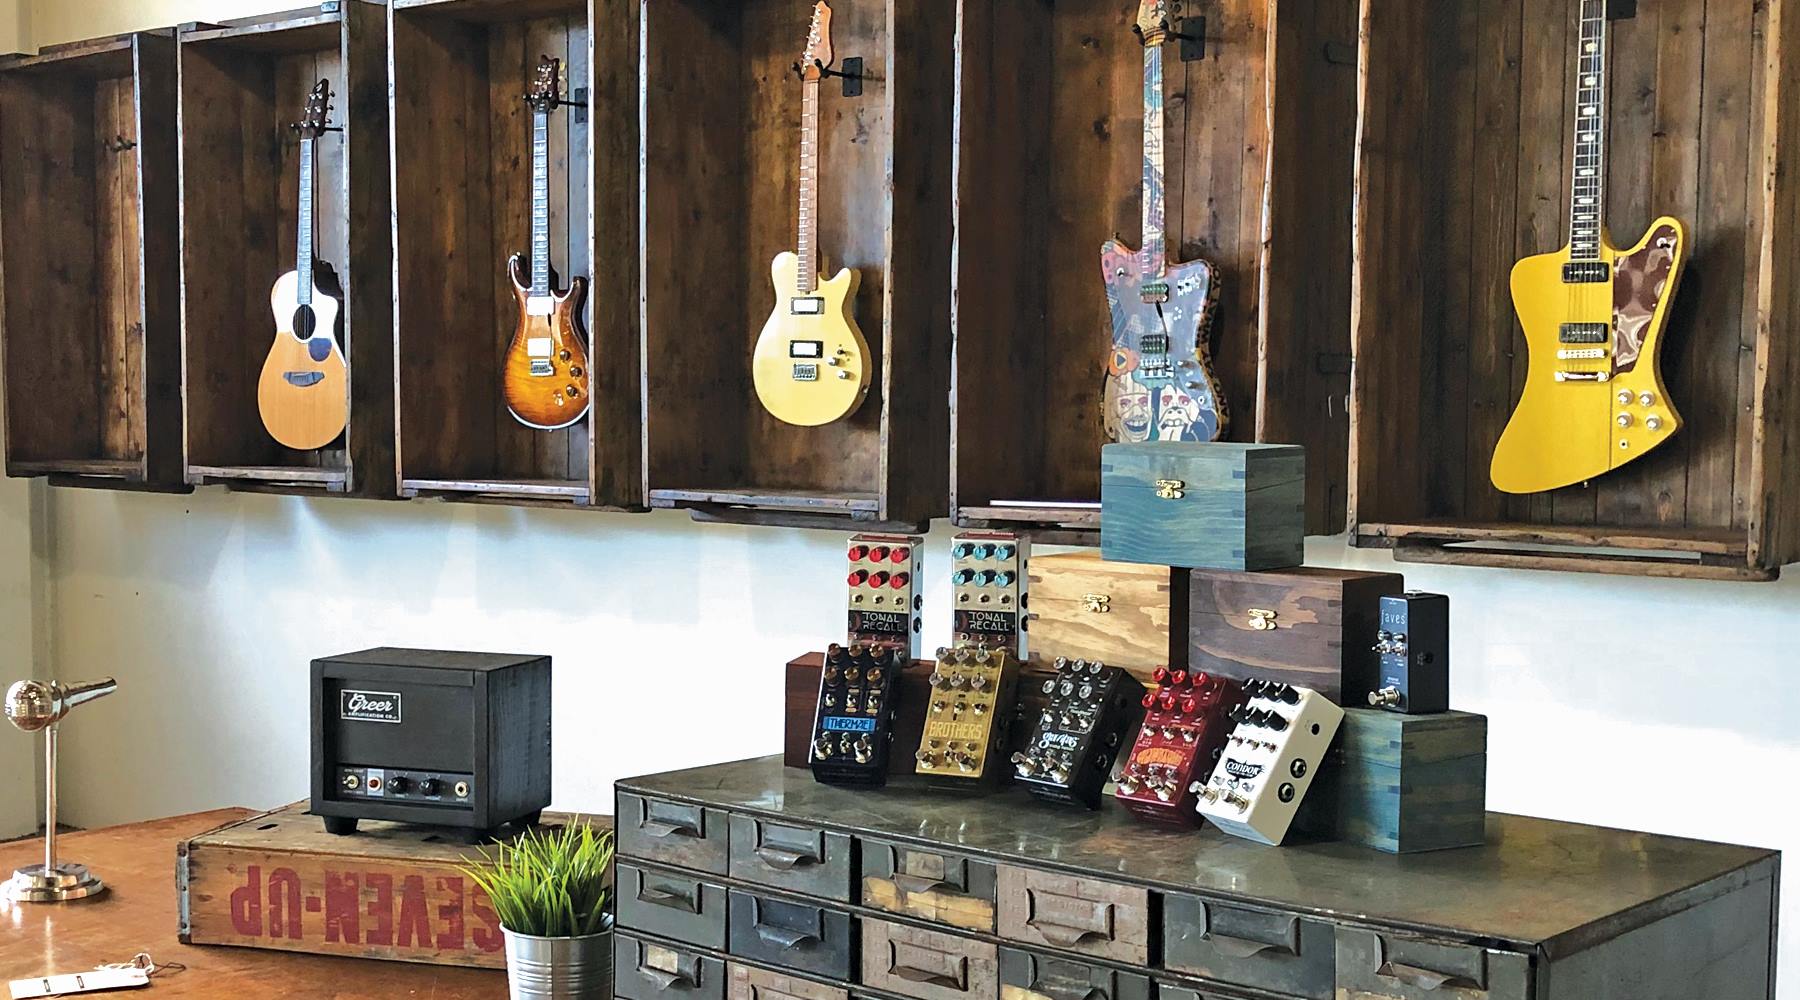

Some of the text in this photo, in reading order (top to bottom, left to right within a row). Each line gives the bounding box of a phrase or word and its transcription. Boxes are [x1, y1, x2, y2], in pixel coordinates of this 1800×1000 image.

[862, 612, 900, 623] TONAL
[968, 612, 1006, 622] TONAL
[862, 621, 903, 632] RECALL
[969, 621, 1009, 631] RECALL
[348, 693, 393, 712] Greer
[928, 721, 982, 739] BROTHERS
[230, 865, 505, 953] SEVEN-UP
